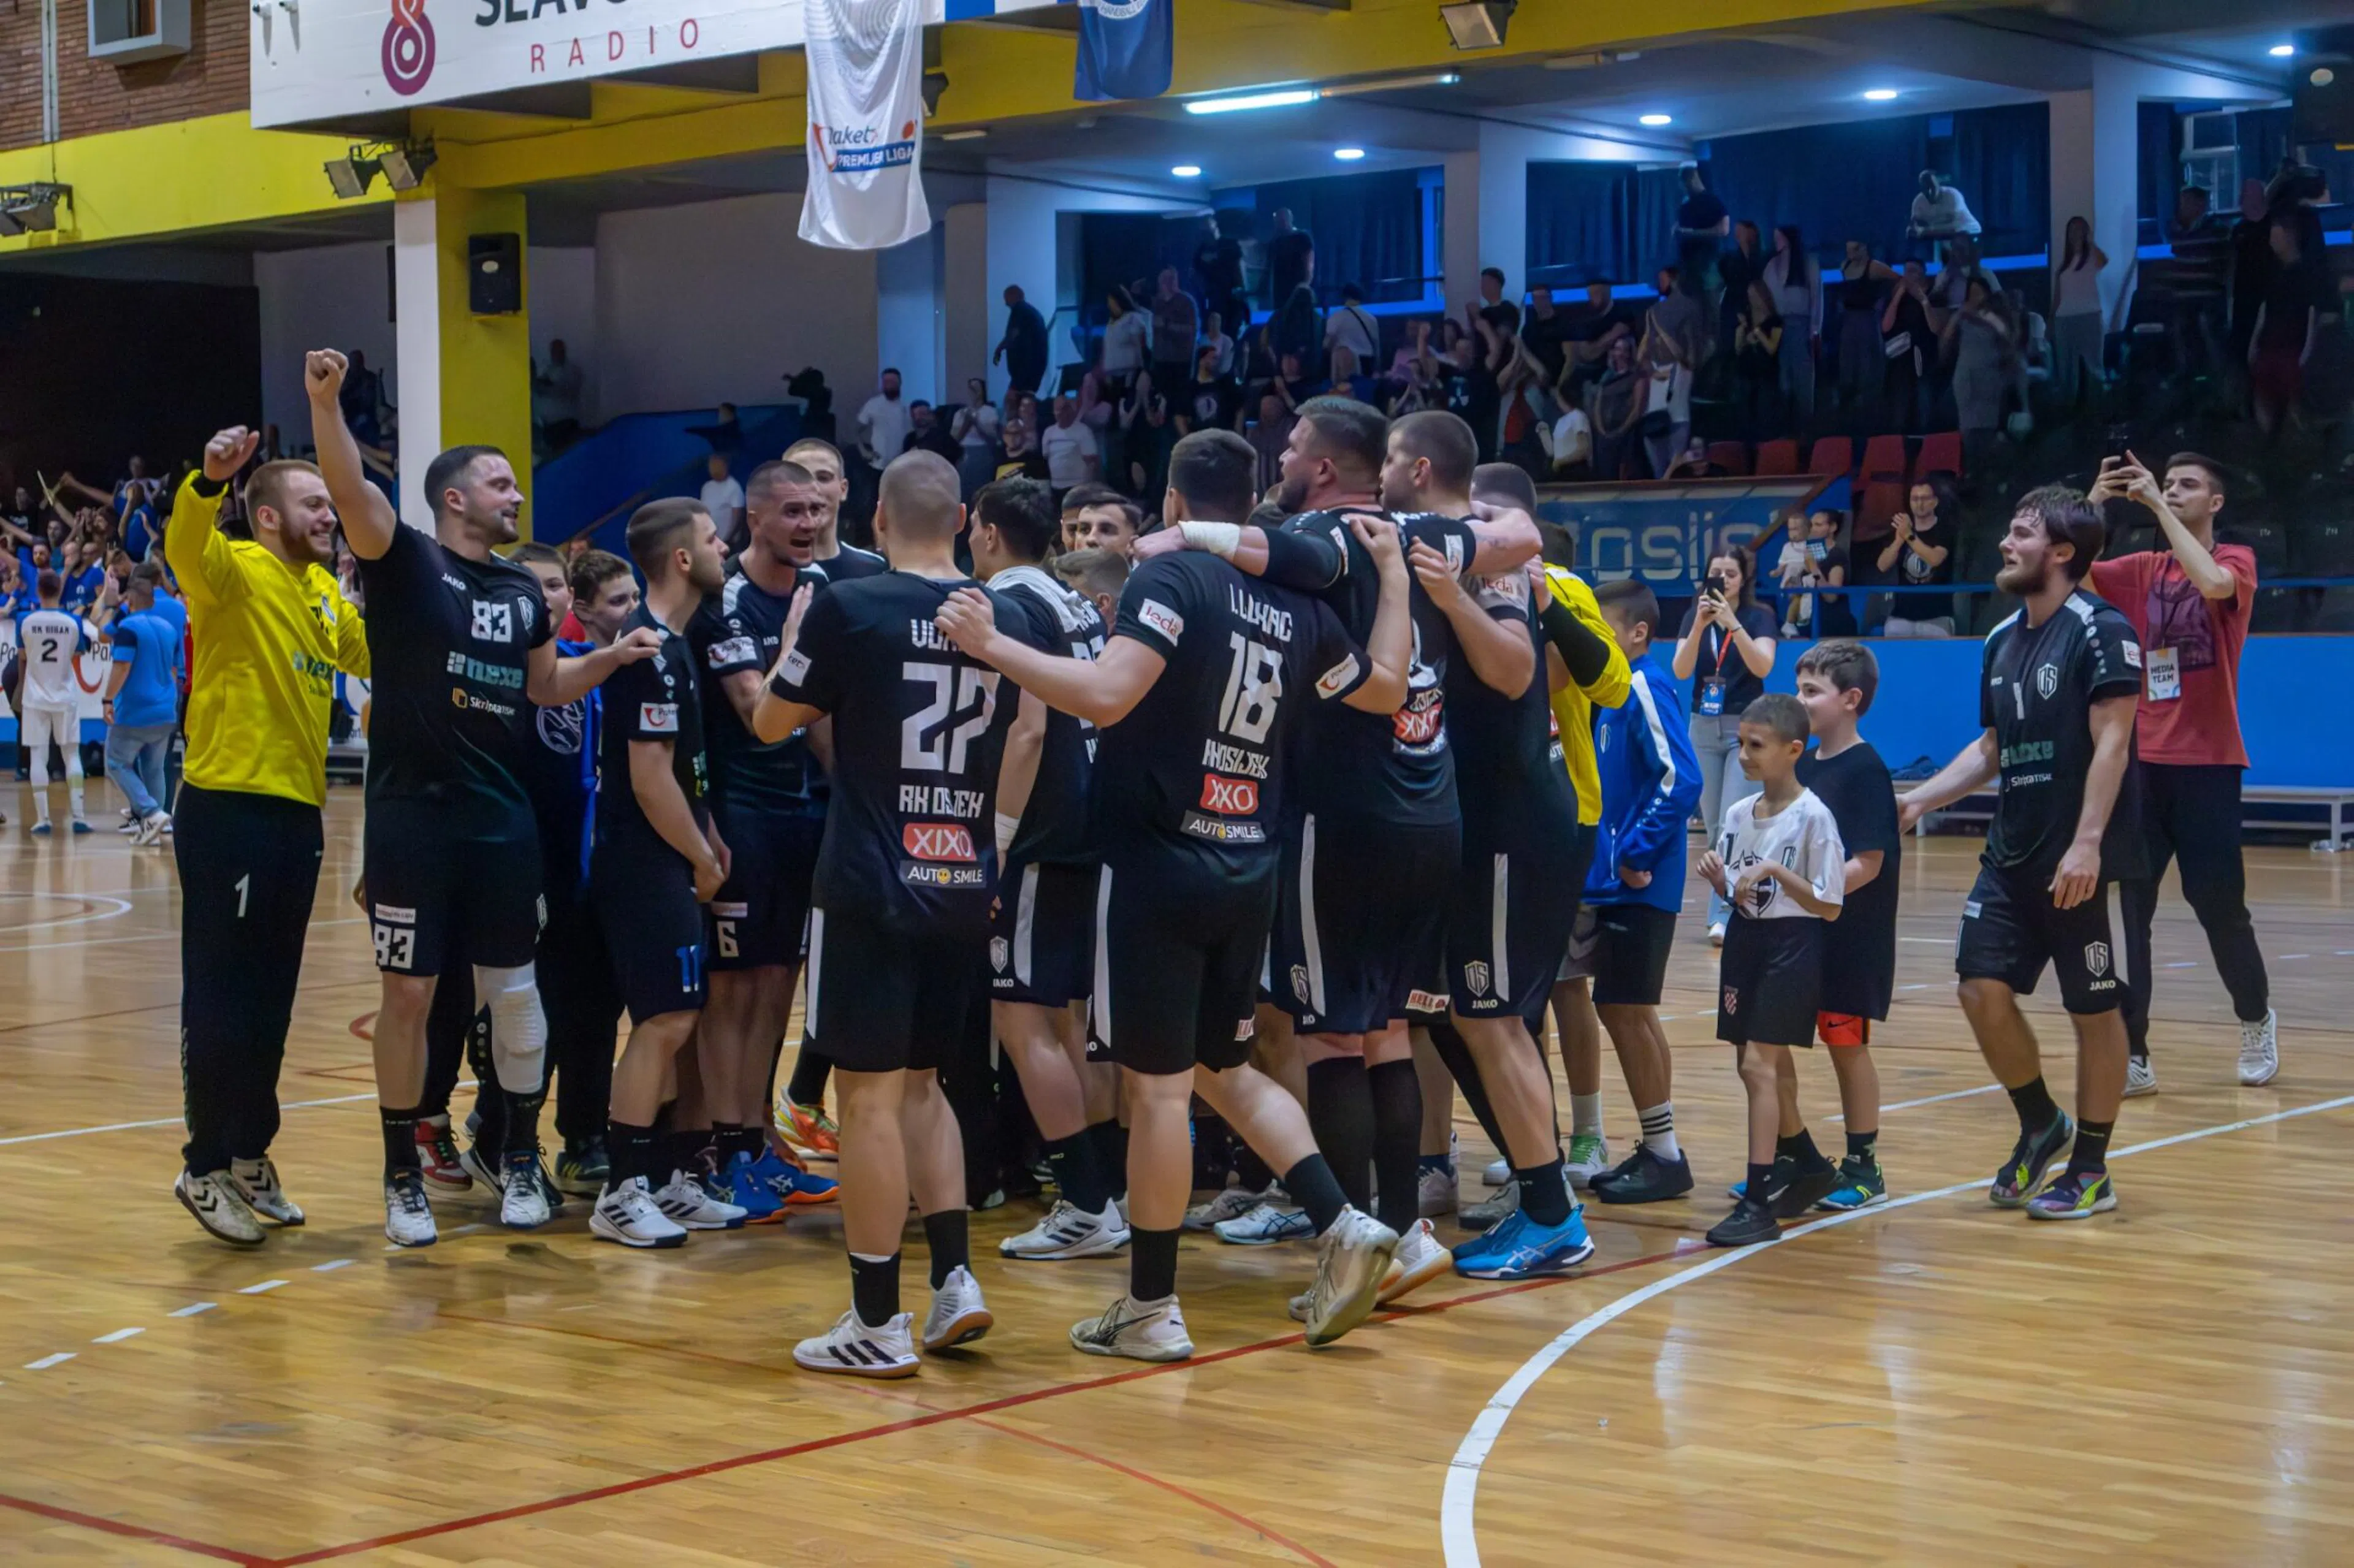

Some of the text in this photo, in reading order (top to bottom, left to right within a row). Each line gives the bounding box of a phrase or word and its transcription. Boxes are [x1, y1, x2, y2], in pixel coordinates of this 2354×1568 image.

[531, 18, 698, 72] RADIO
[441, 573, 467, 590] JAKO
[471, 599, 512, 642] 83
[1145, 606, 1178, 636] leda
[40, 638, 58, 662] 2
[466, 657, 523, 689] nexe
[2150, 663, 2175, 674] MEDIA
[2152, 673, 2174, 683] TEAM
[1219, 631, 1283, 744] 18
[899, 785, 985, 818] RK OSJEK
[912, 828, 972, 857] XIXO
[1227, 826, 1259, 839] SMILE
[953, 870, 983, 883] SMILE
[235, 873, 249, 918] 1
[374, 923, 415, 969] 83
[717, 921, 739, 957] 6
[676, 945, 699, 992] 11
[2089, 980, 2116, 991] JAKO
[1472, 999, 1498, 1009] JAKO
